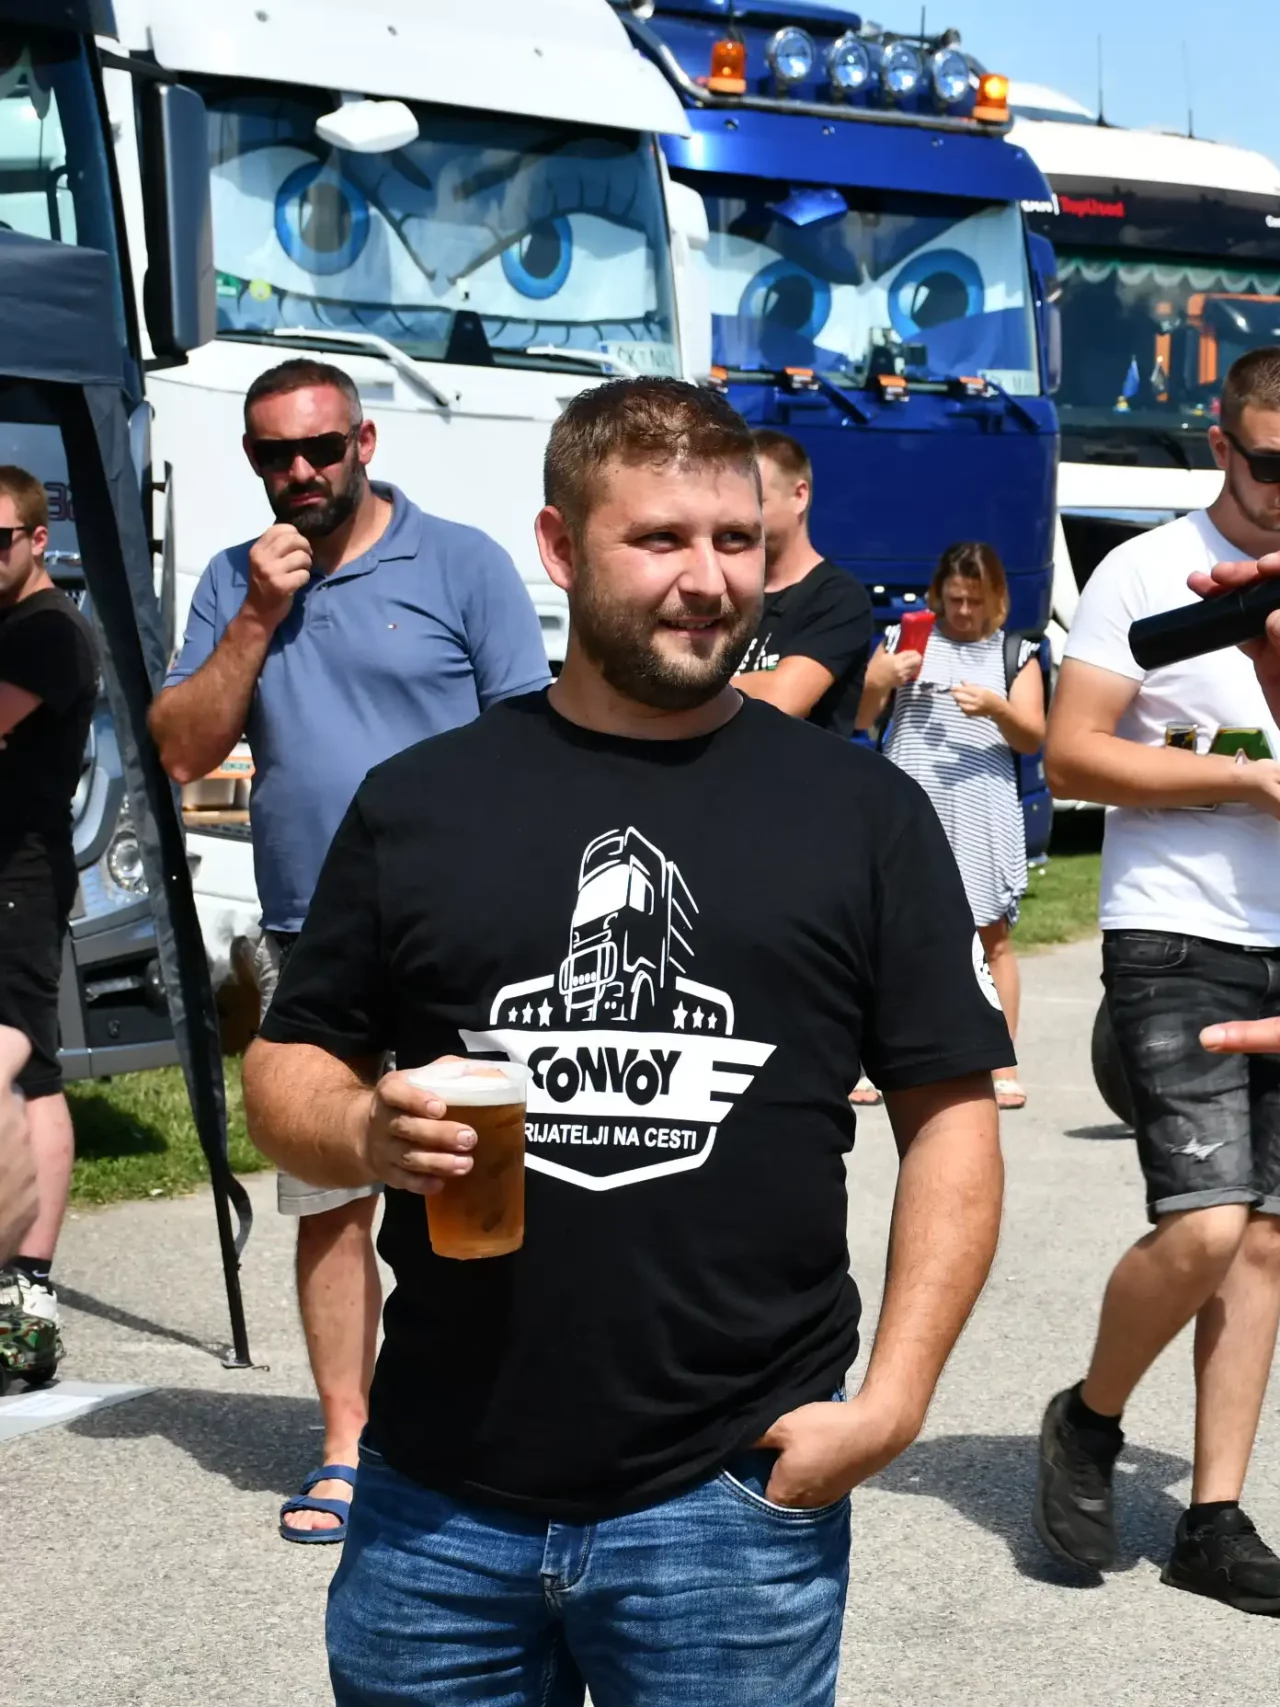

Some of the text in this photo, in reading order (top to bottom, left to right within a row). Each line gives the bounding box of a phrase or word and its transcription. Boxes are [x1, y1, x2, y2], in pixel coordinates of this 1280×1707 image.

[526, 1046, 683, 1106] CONVOY
[524, 1122, 698, 1150] RIJATELJI NA CESTI
